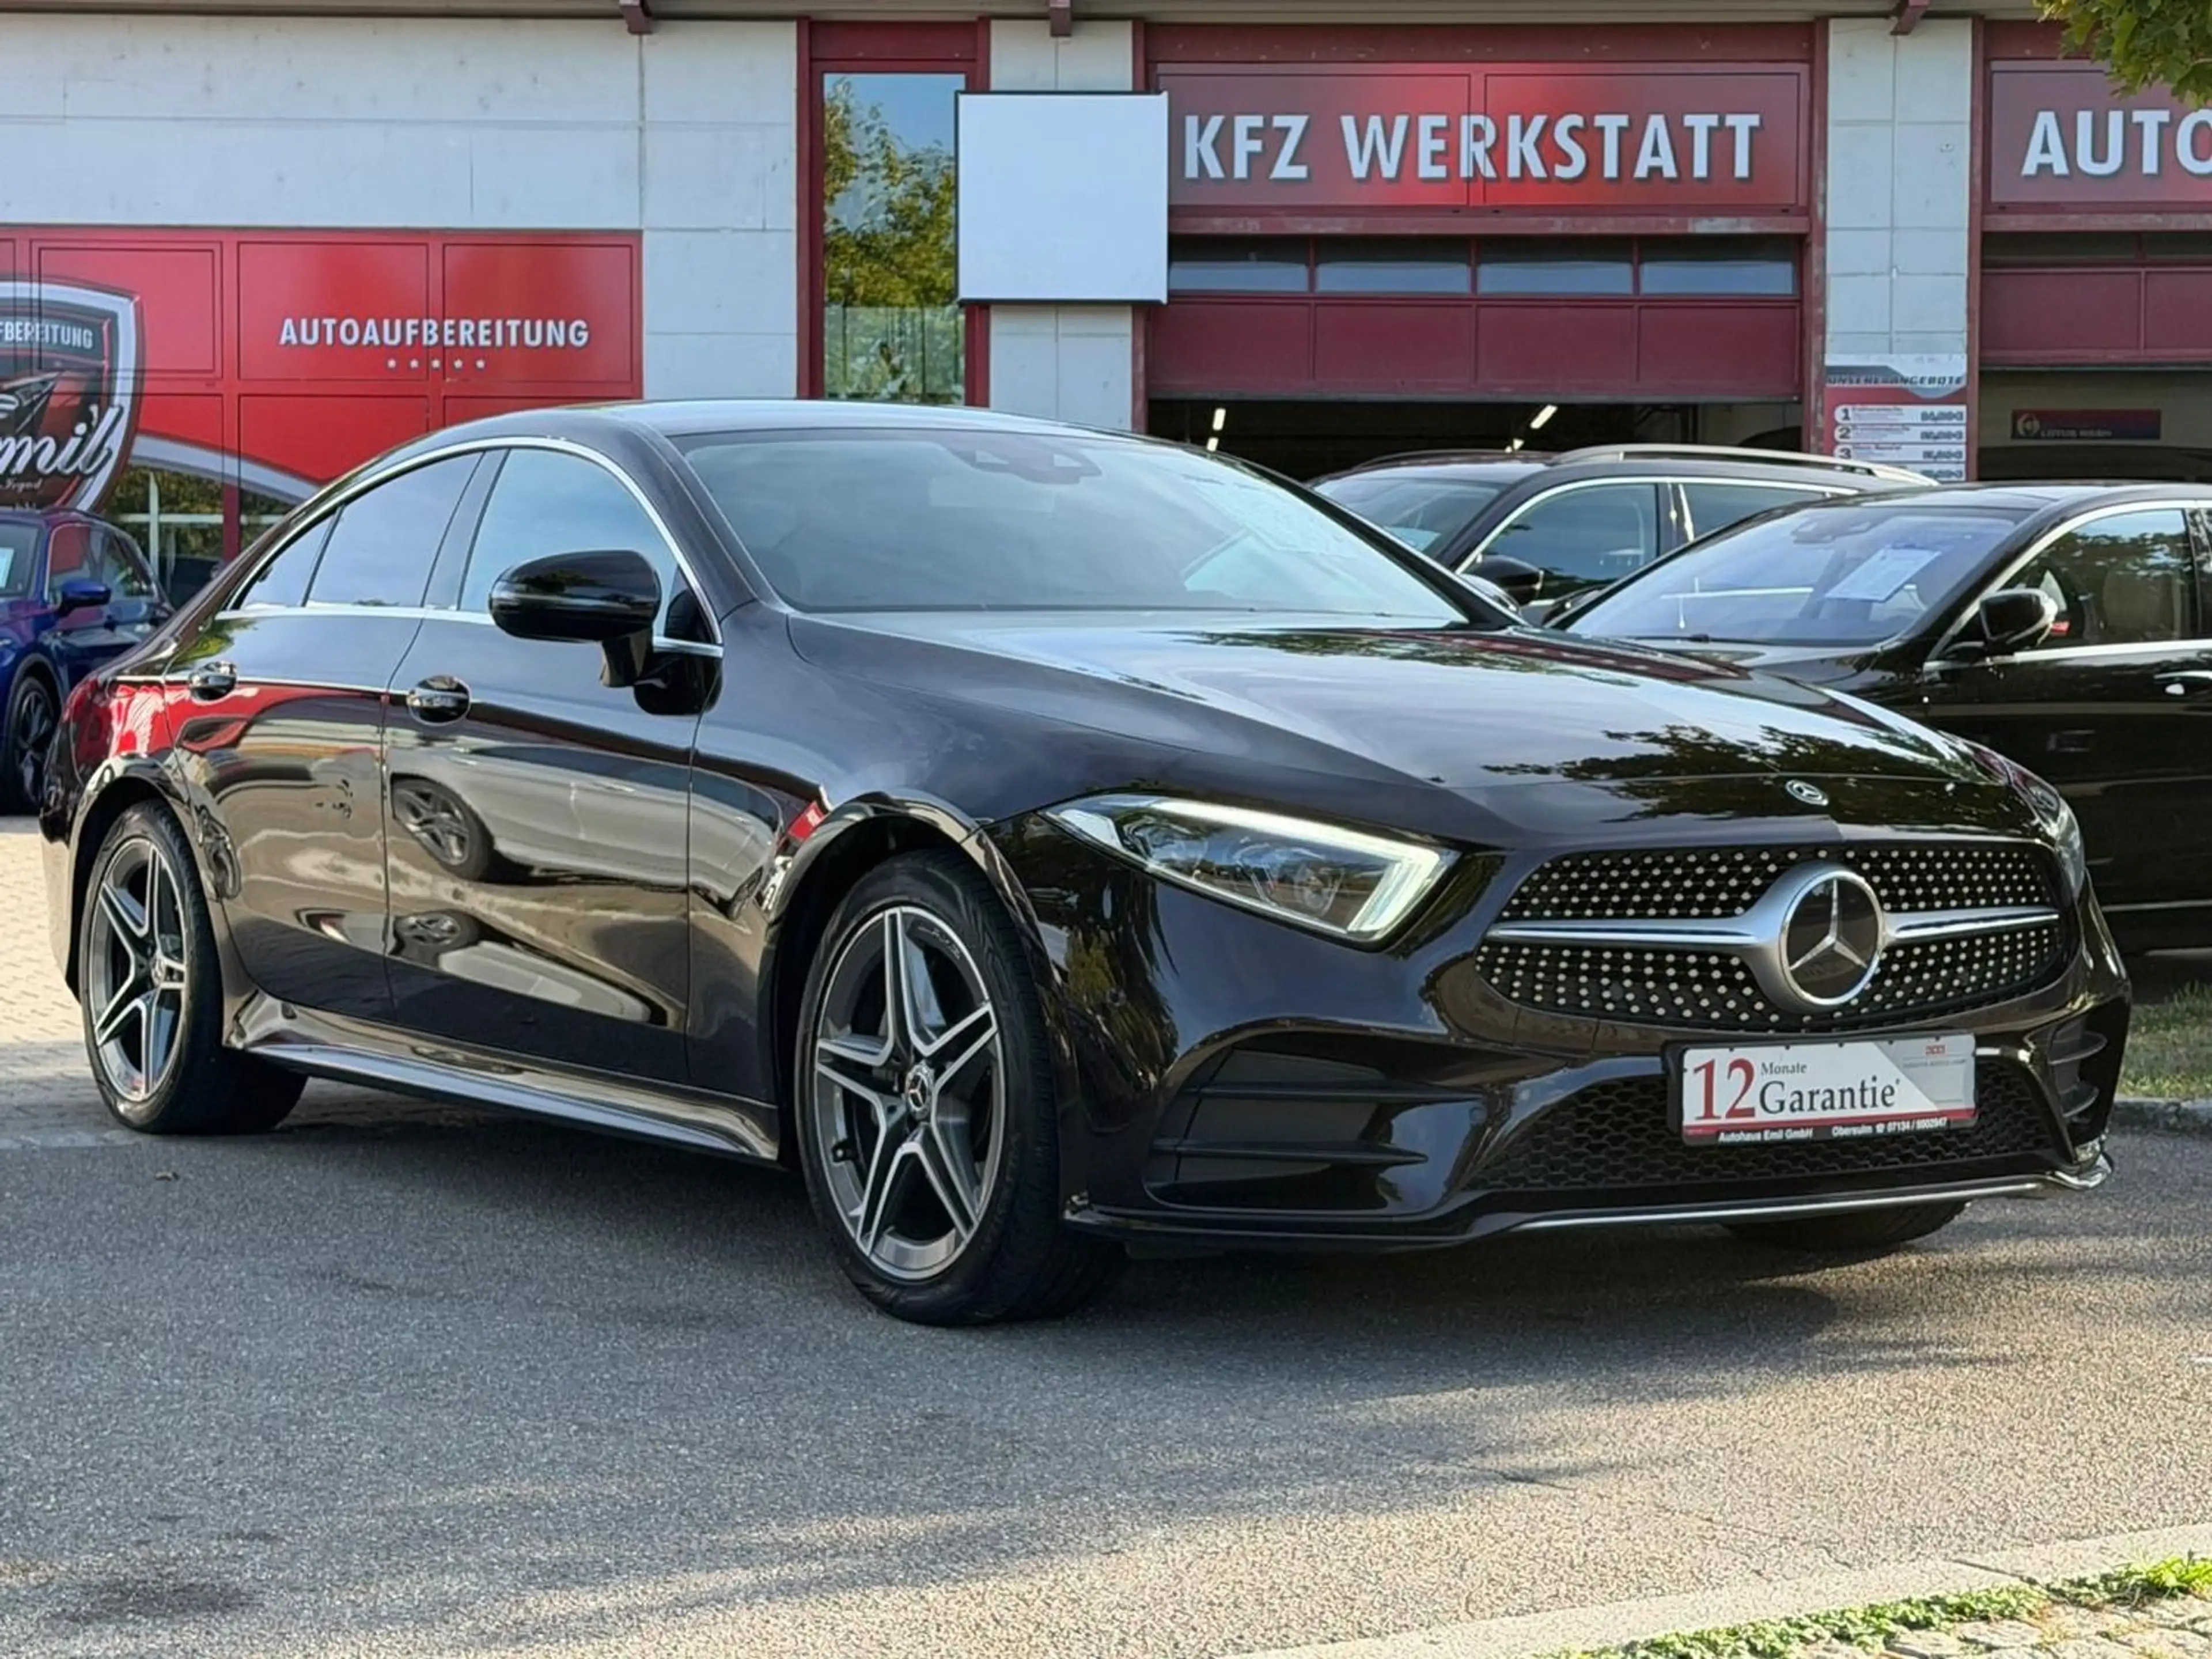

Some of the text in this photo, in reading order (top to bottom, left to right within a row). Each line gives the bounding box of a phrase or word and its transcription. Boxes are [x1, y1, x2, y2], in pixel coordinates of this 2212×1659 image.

[1184, 113, 1762, 181] KFZ WERKSTATT
[2021, 109, 2212, 176] AUTO
[279, 317, 589, 348] AUTOAUFBEREITUNG
[1841, 408, 1851, 421] 1
[1839, 425, 1851, 440] 2
[1839, 448, 1851, 460] 3
[1693, 1058, 1808, 1120] 12 Monate
[1718, 1130, 1762, 1142] Autohaus
[1763, 1128, 1783, 1141] Emil
[1785, 1126, 1814, 1140] GmbH
